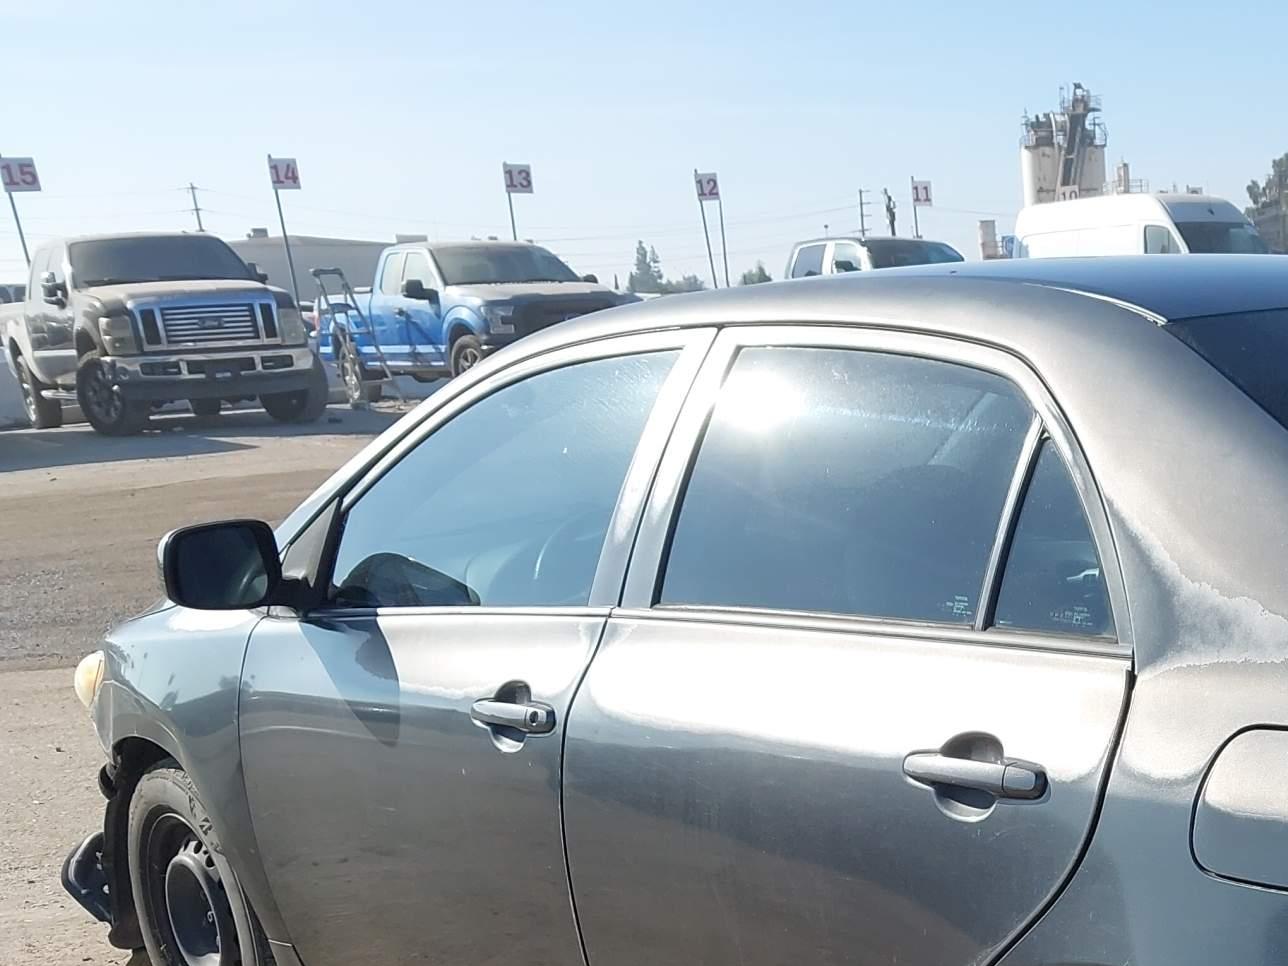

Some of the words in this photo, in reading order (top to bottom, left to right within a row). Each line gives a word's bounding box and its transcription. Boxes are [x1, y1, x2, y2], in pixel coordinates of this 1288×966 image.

[1, 163, 38, 186] 15
[270, 163, 299, 184] 14
[505, 169, 532, 188] 13
[696, 178, 719, 196] 12
[912, 186, 931, 202] 11
